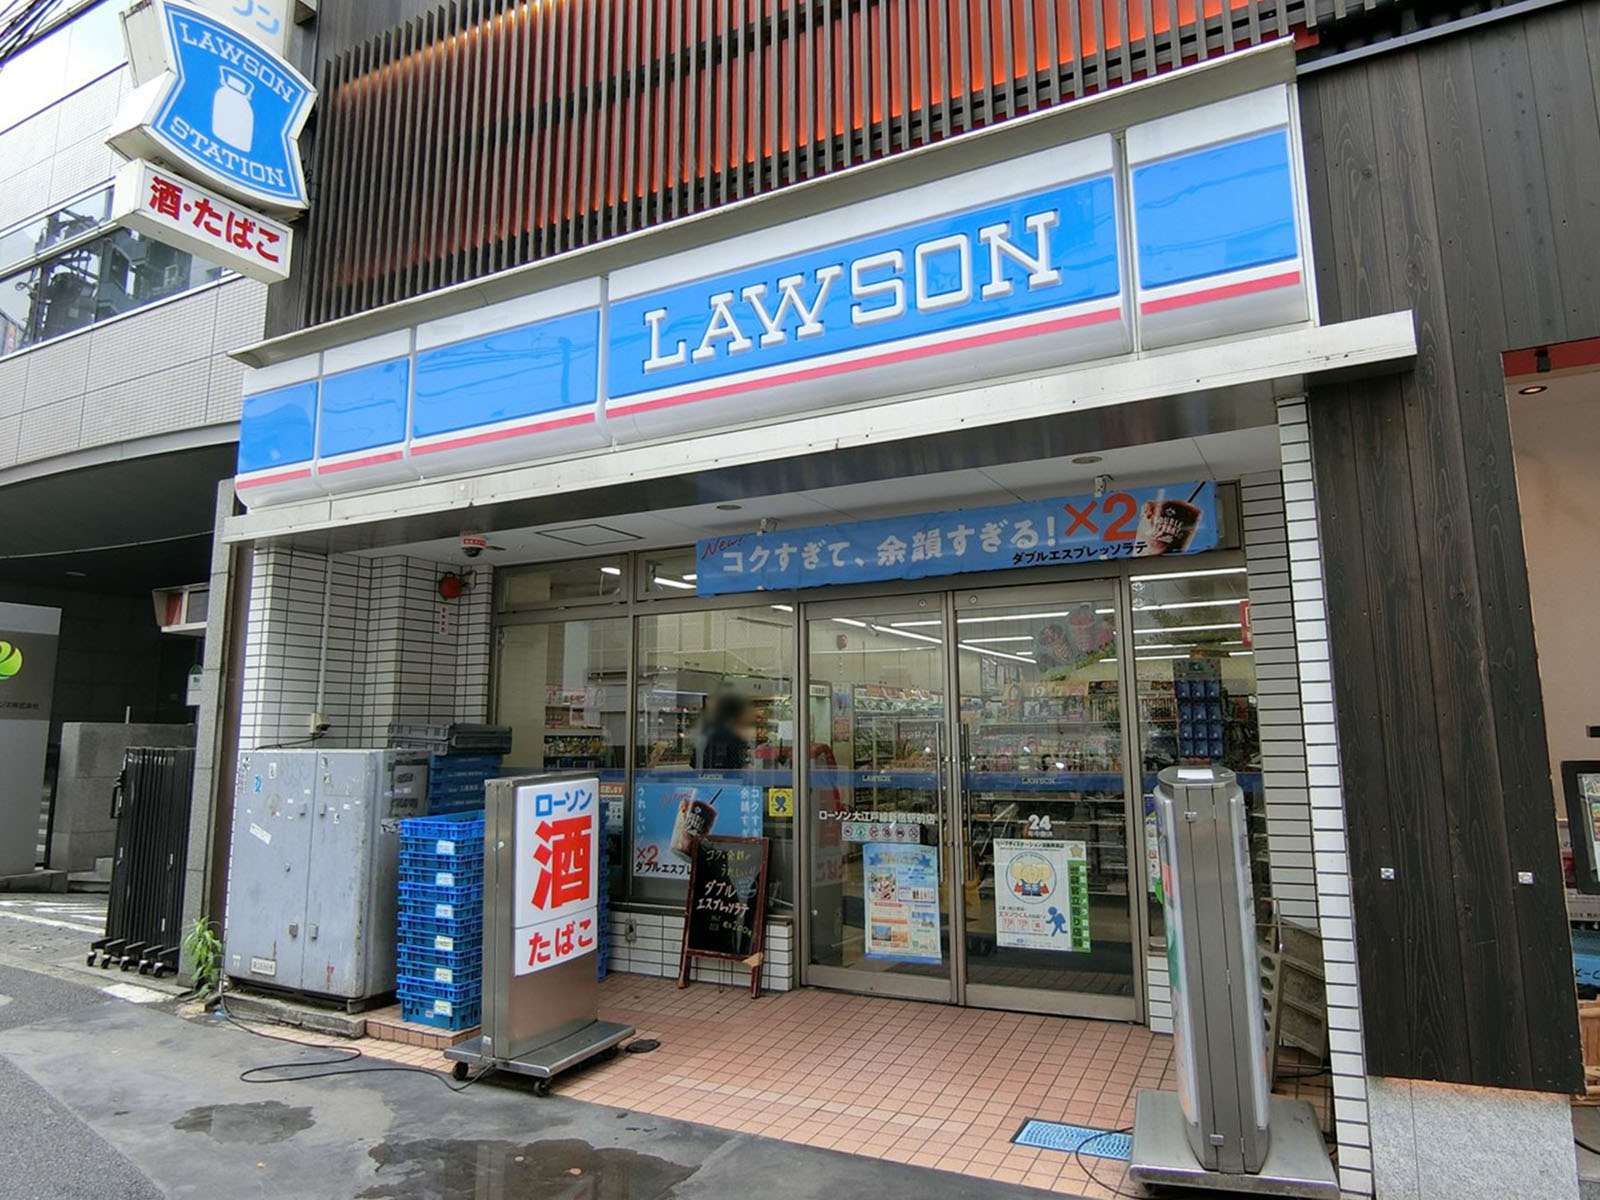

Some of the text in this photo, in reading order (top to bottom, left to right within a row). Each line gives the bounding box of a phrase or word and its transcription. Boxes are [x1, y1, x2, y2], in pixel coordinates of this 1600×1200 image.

[180, 22, 295, 103] LAWSON
[170, 116, 286, 188] STATION
[149, 175, 280, 263] 酒・たばこ
[643, 209, 1061, 374] LAWSON
[1012, 542, 1148, 565] ダブルエスプレッソラテ
[535, 787, 592, 817] ローソン
[1028, 814, 1051, 831] 24
[531, 814, 592, 910] 酒
[696, 898, 750, 918] エスプレッソラテ
[704, 880, 738, 898] ダブル
[528, 918, 594, 967] たばこ
